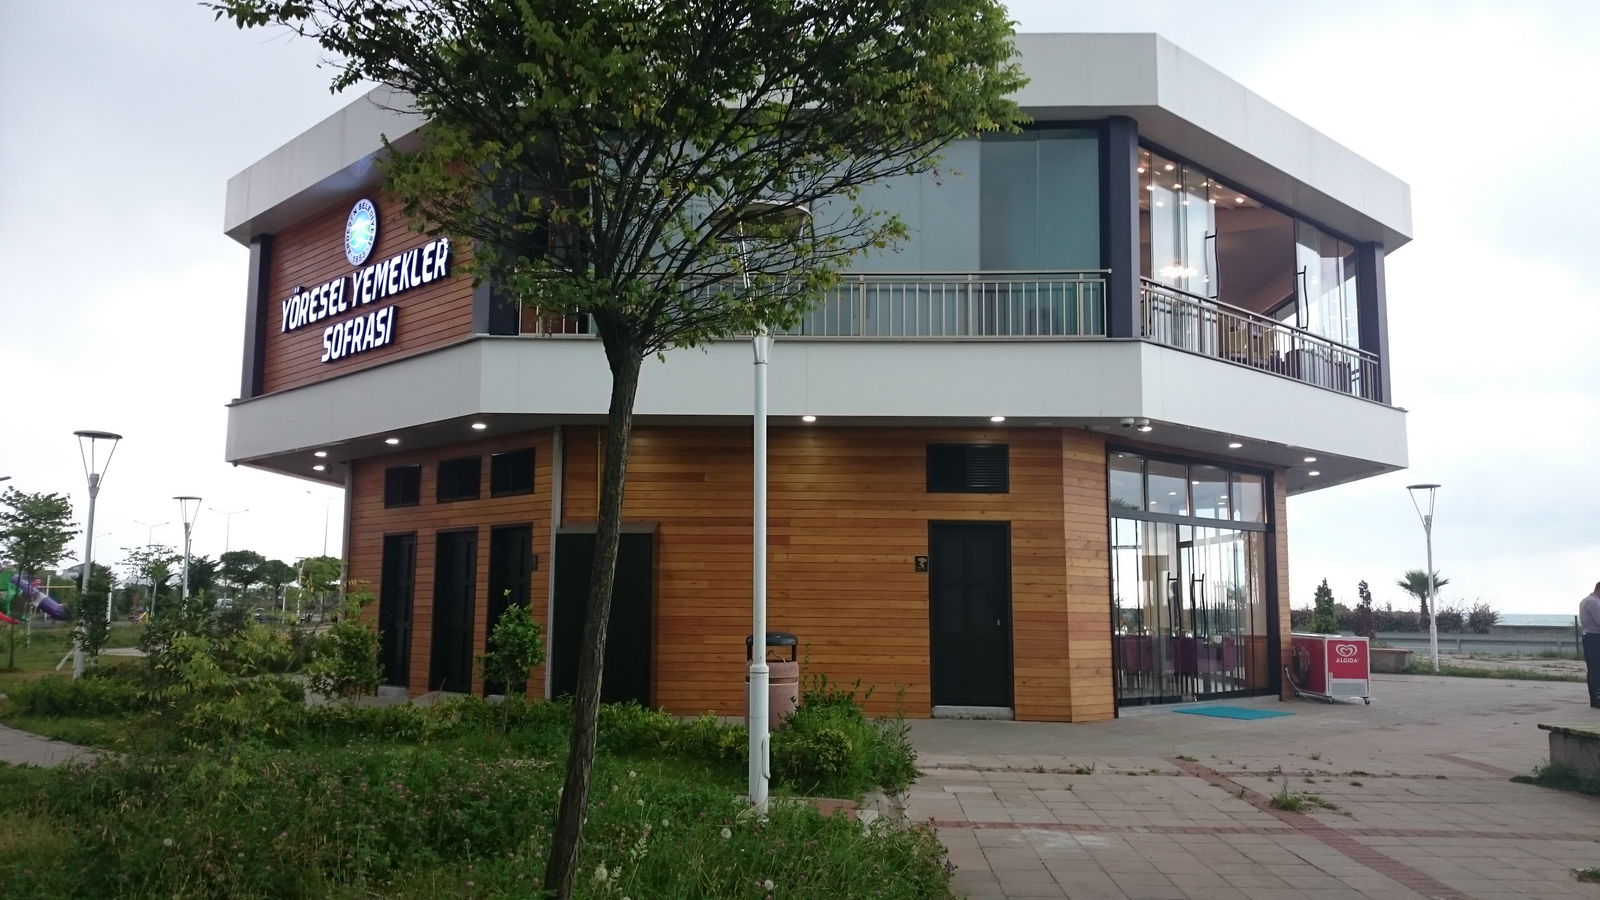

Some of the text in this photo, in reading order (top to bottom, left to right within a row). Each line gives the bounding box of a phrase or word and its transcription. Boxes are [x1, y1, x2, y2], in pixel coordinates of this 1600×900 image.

[281, 238, 448, 333] YÖRESEL YEMEKLER
[321, 306, 394, 363] SOFRASI
